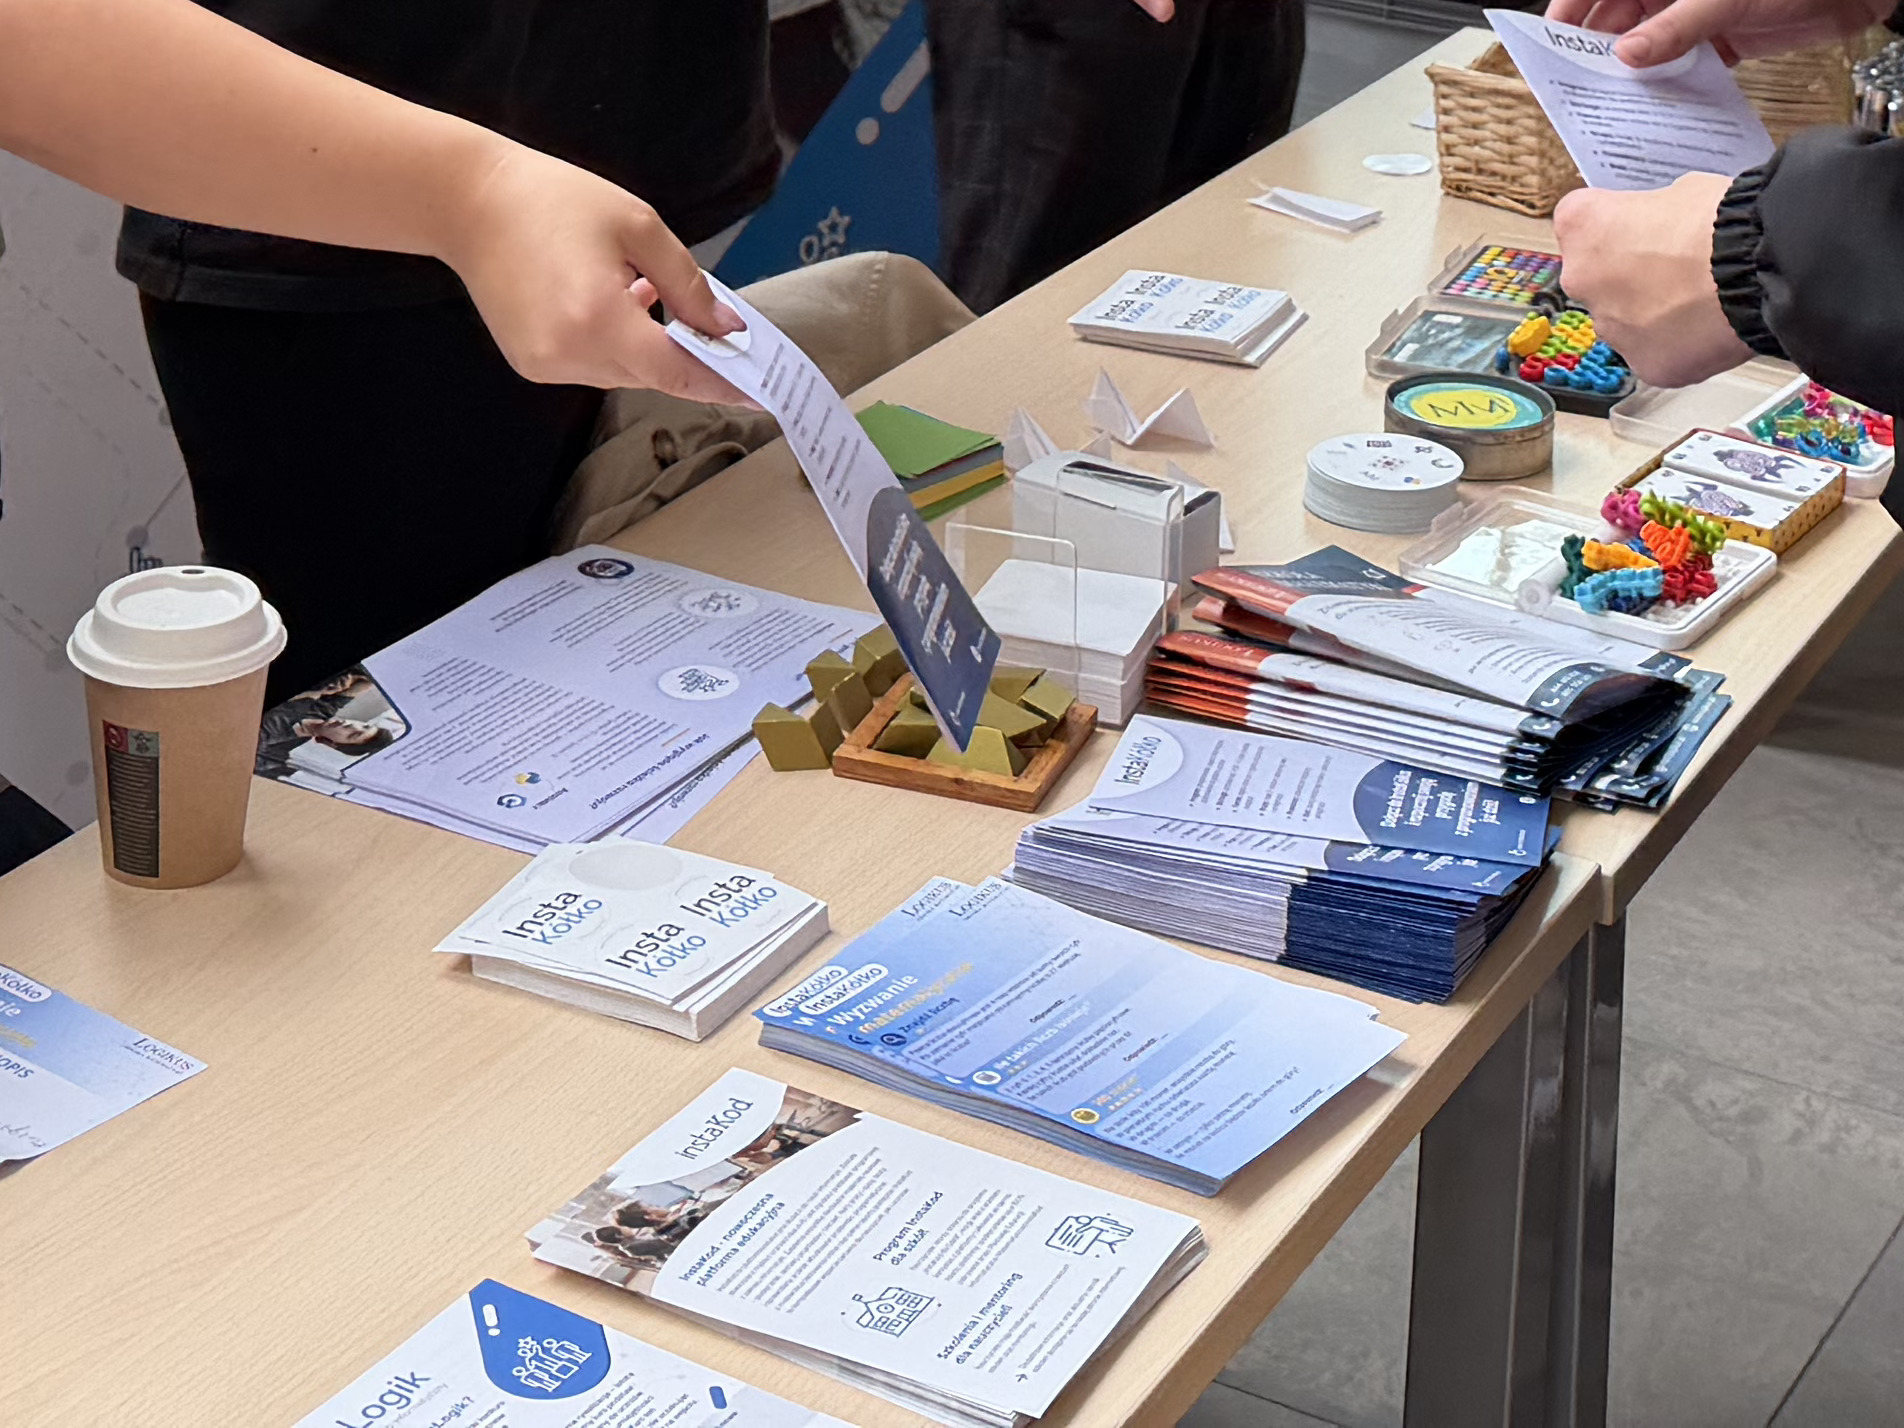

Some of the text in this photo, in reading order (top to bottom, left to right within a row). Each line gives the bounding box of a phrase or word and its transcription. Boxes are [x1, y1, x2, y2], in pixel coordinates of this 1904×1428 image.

[1544, 24, 1617, 57] InstaK
[502, 891, 583, 939] Insta
[679, 874, 756, 918] Insta
[708, 886, 778, 928] Kółko
[531, 898, 604, 946] Kółko
[604, 923, 686, 969] Insta
[634, 934, 707, 978] Kółko
[805, 965, 884, 1014] InstaKółko
[826, 974, 919, 1029] Wyzwanie
[335, 1370, 432, 1428] Logik
